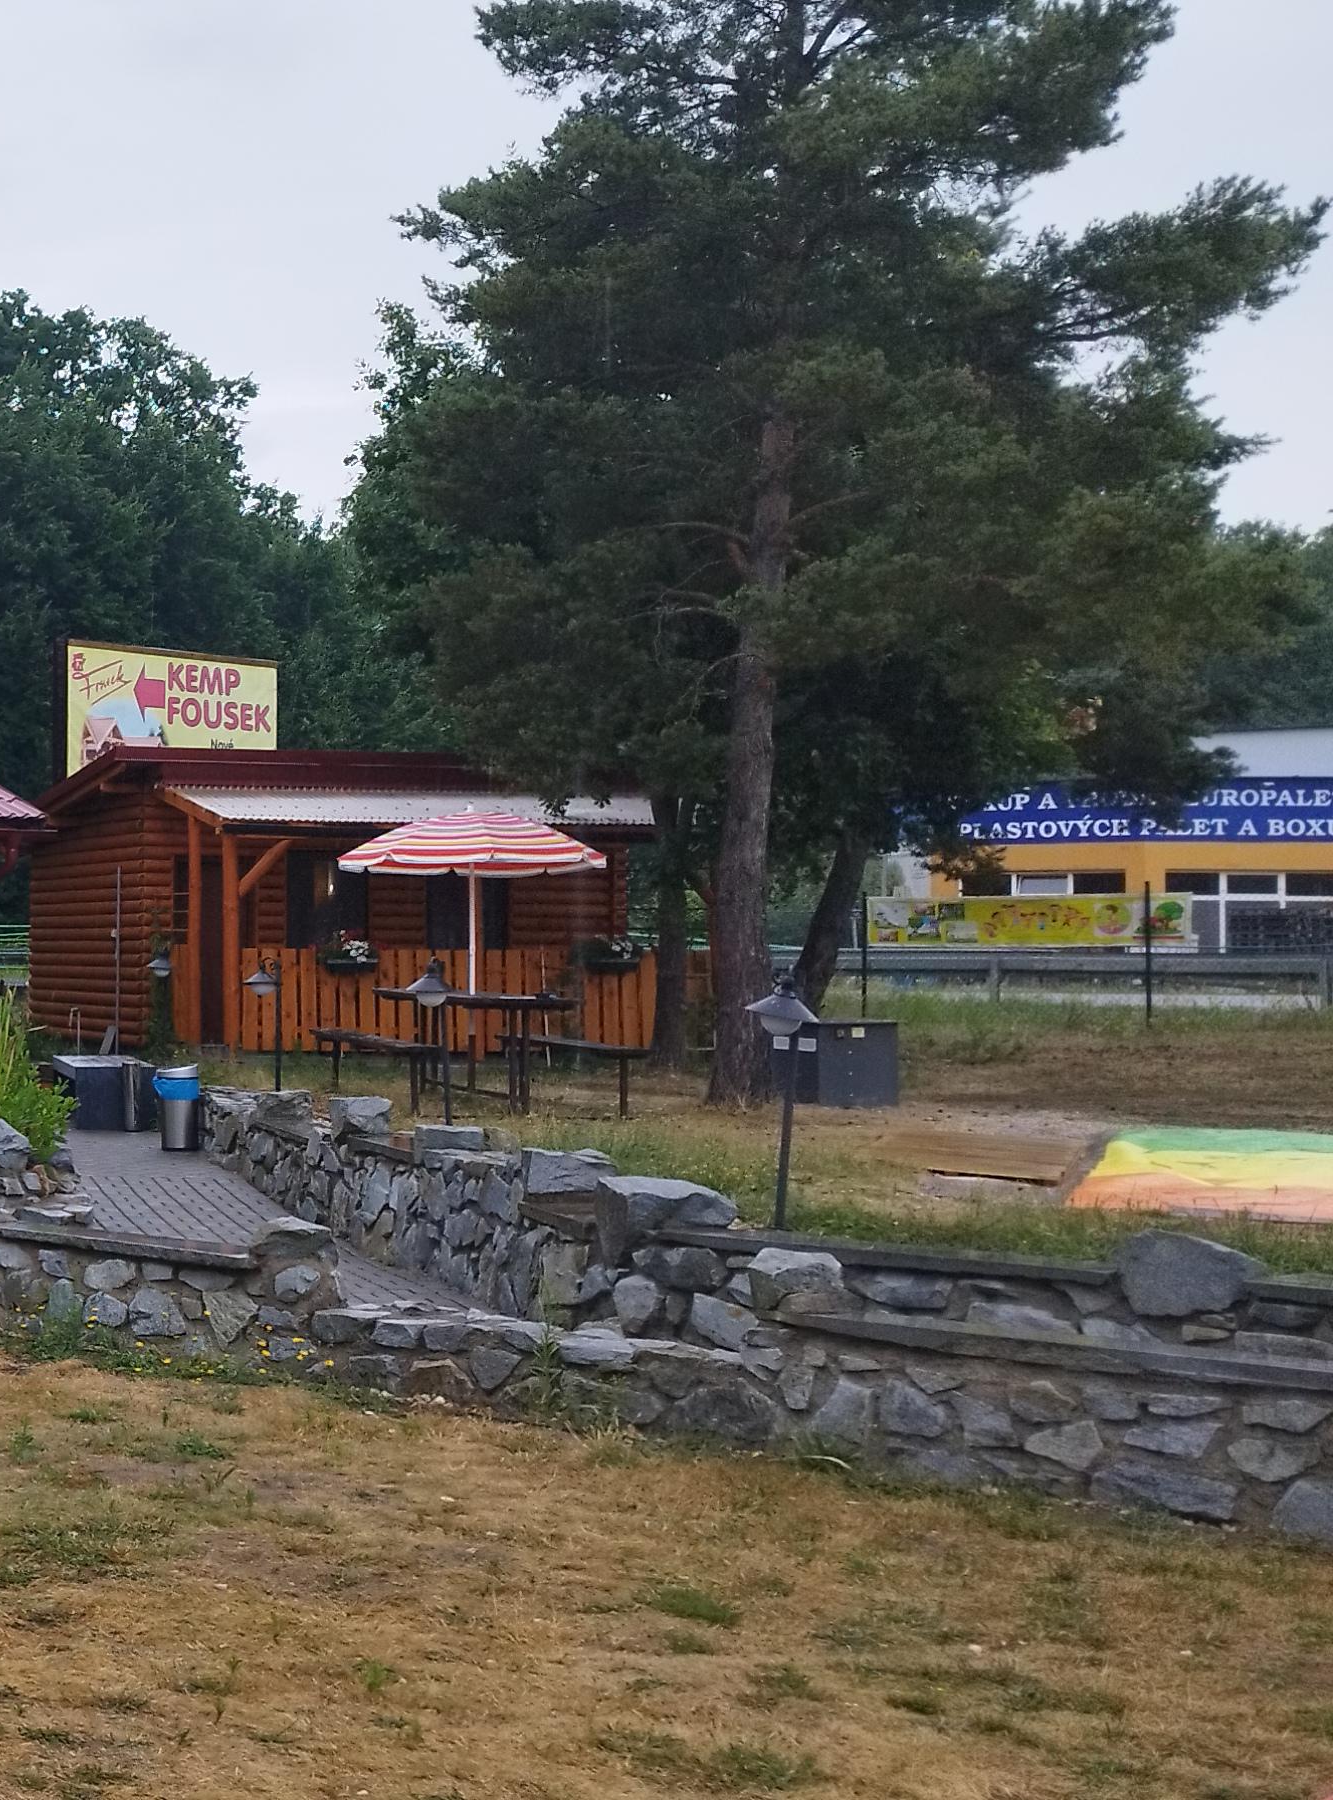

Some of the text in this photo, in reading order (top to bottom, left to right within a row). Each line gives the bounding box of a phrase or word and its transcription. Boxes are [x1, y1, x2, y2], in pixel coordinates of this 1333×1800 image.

[167, 662, 241, 697] KEMP
[167, 696, 272, 734] FOUSEK
[1037, 792, 1058, 811] A
[1236, 819, 1259, 836] A
